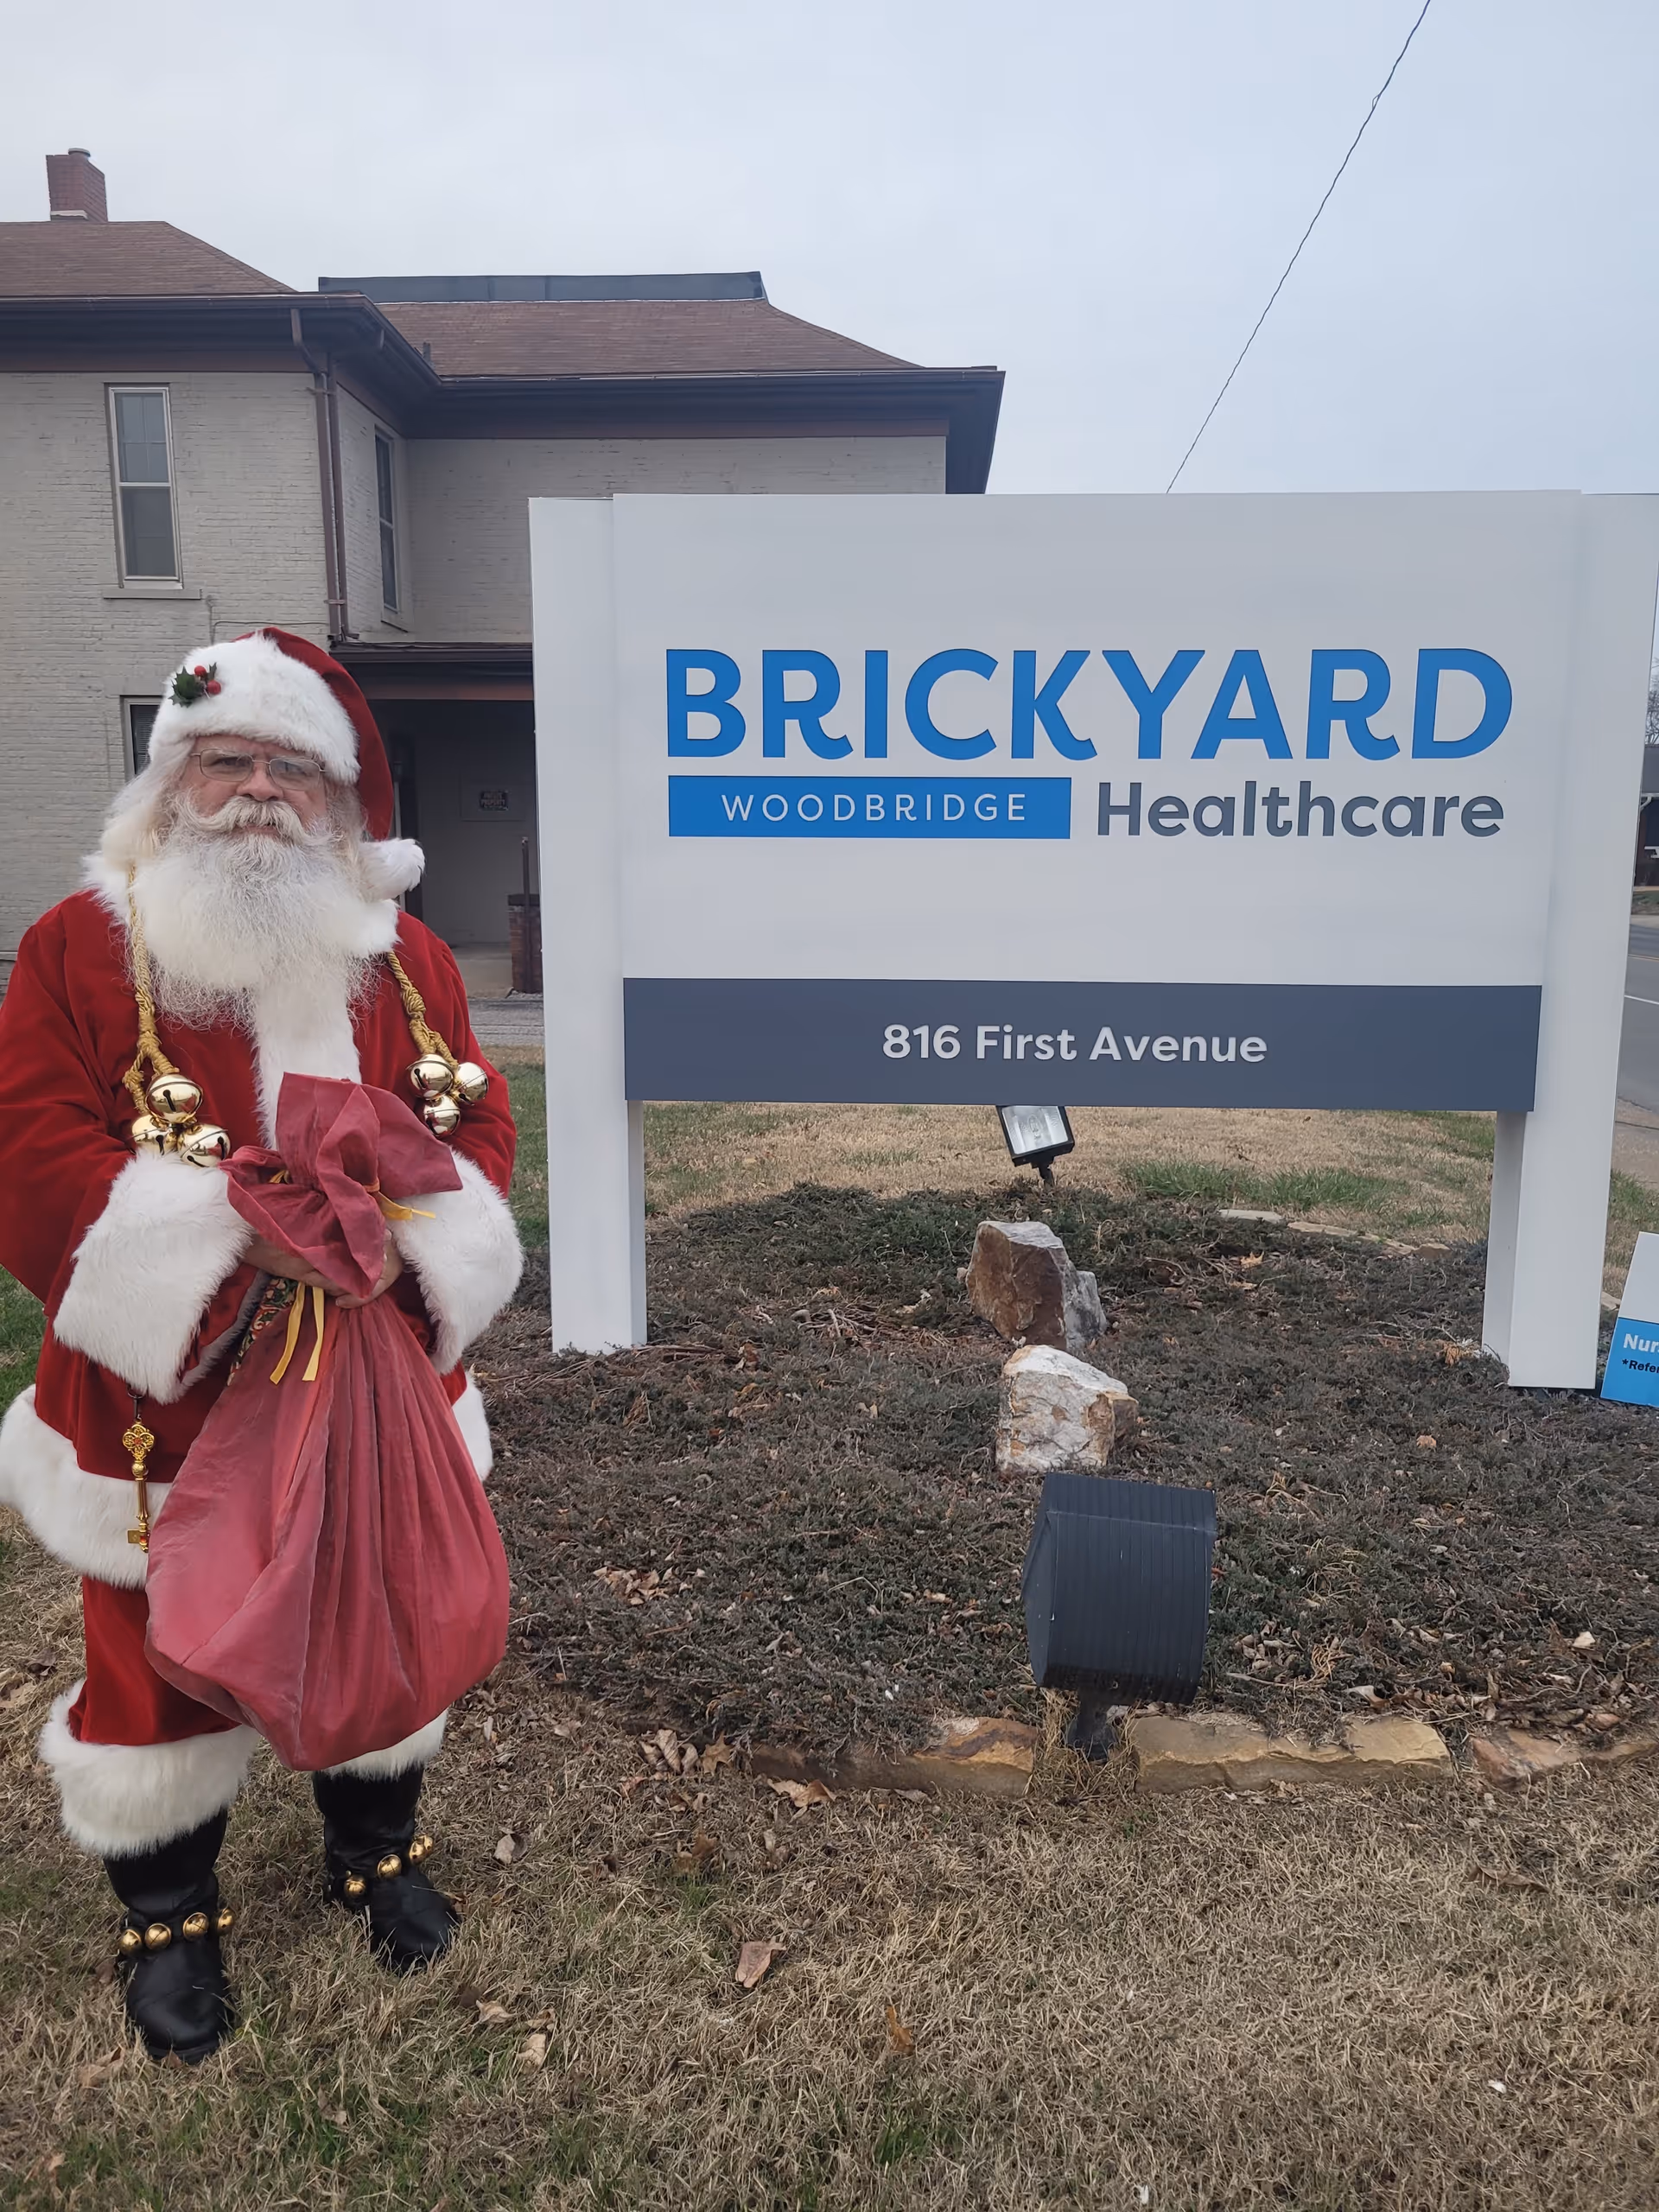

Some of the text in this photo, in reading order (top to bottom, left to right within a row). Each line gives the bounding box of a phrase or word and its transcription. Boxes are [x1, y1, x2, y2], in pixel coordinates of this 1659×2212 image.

[666, 648, 1512, 760] BRICKYARD
[721, 793, 1027, 822] WOODBRIDGE
[1097, 780, 1504, 837] Healthcare
[882, 1024, 1268, 1063] 816 First Avenue
[1623, 1333, 1659, 1353] Nur
